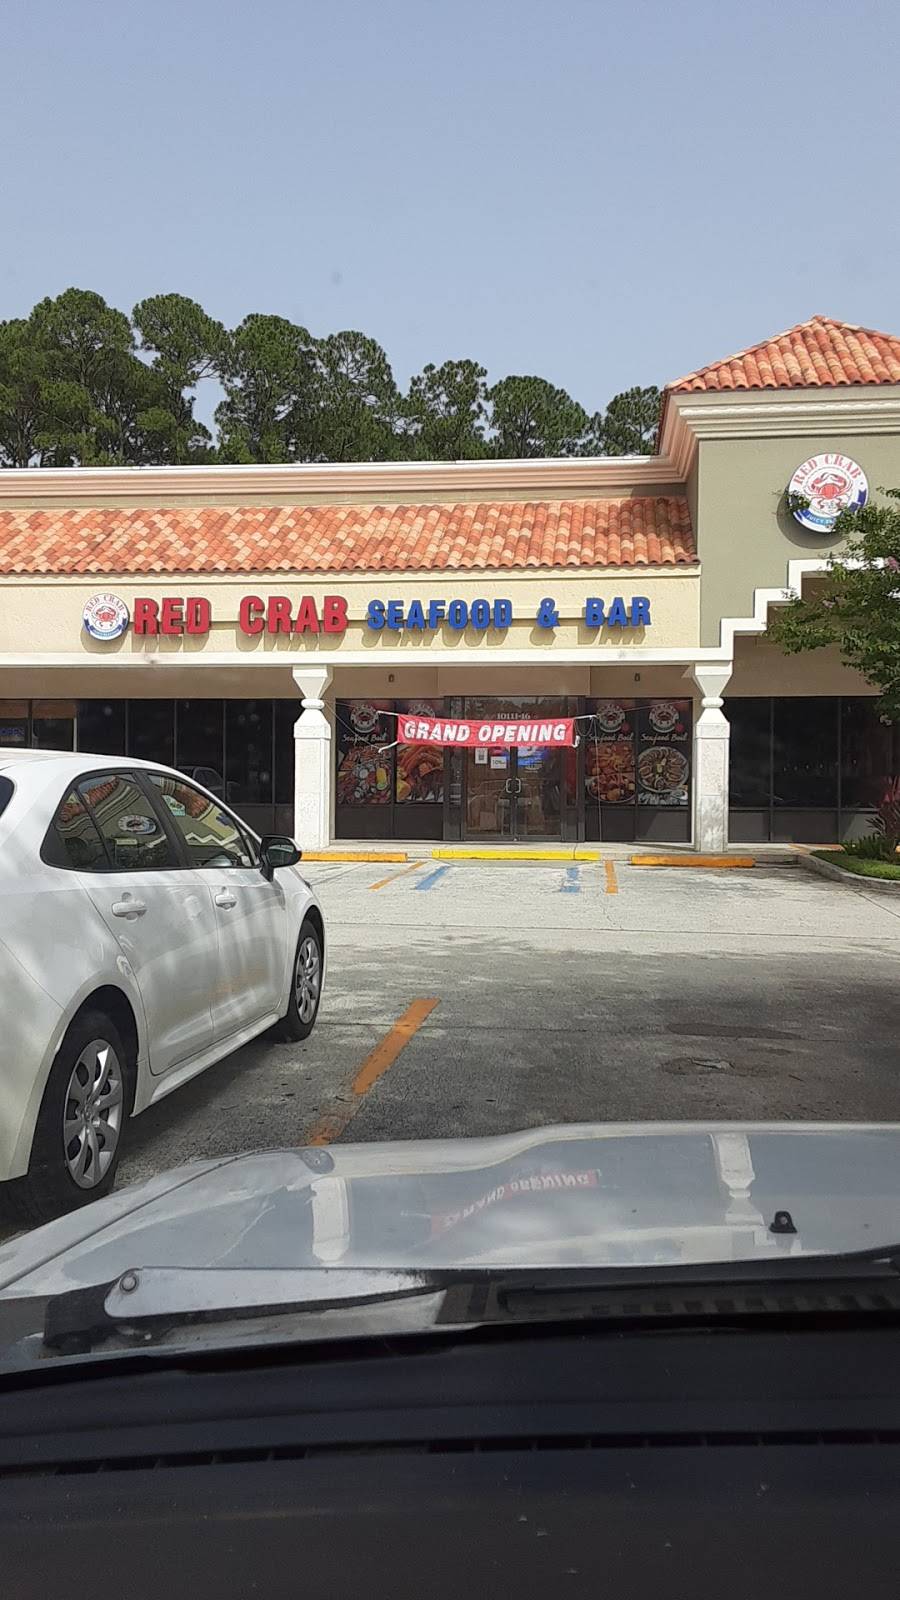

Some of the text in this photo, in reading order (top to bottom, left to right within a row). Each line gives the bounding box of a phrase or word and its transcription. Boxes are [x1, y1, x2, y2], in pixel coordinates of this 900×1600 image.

[793, 454, 861, 485] RED CRAB
[85, 595, 124, 611] RED CRAB
[134, 595, 652, 635] RED CRAB SEAFOOD & BAR
[404, 720, 567, 743] GRAND OPENING
